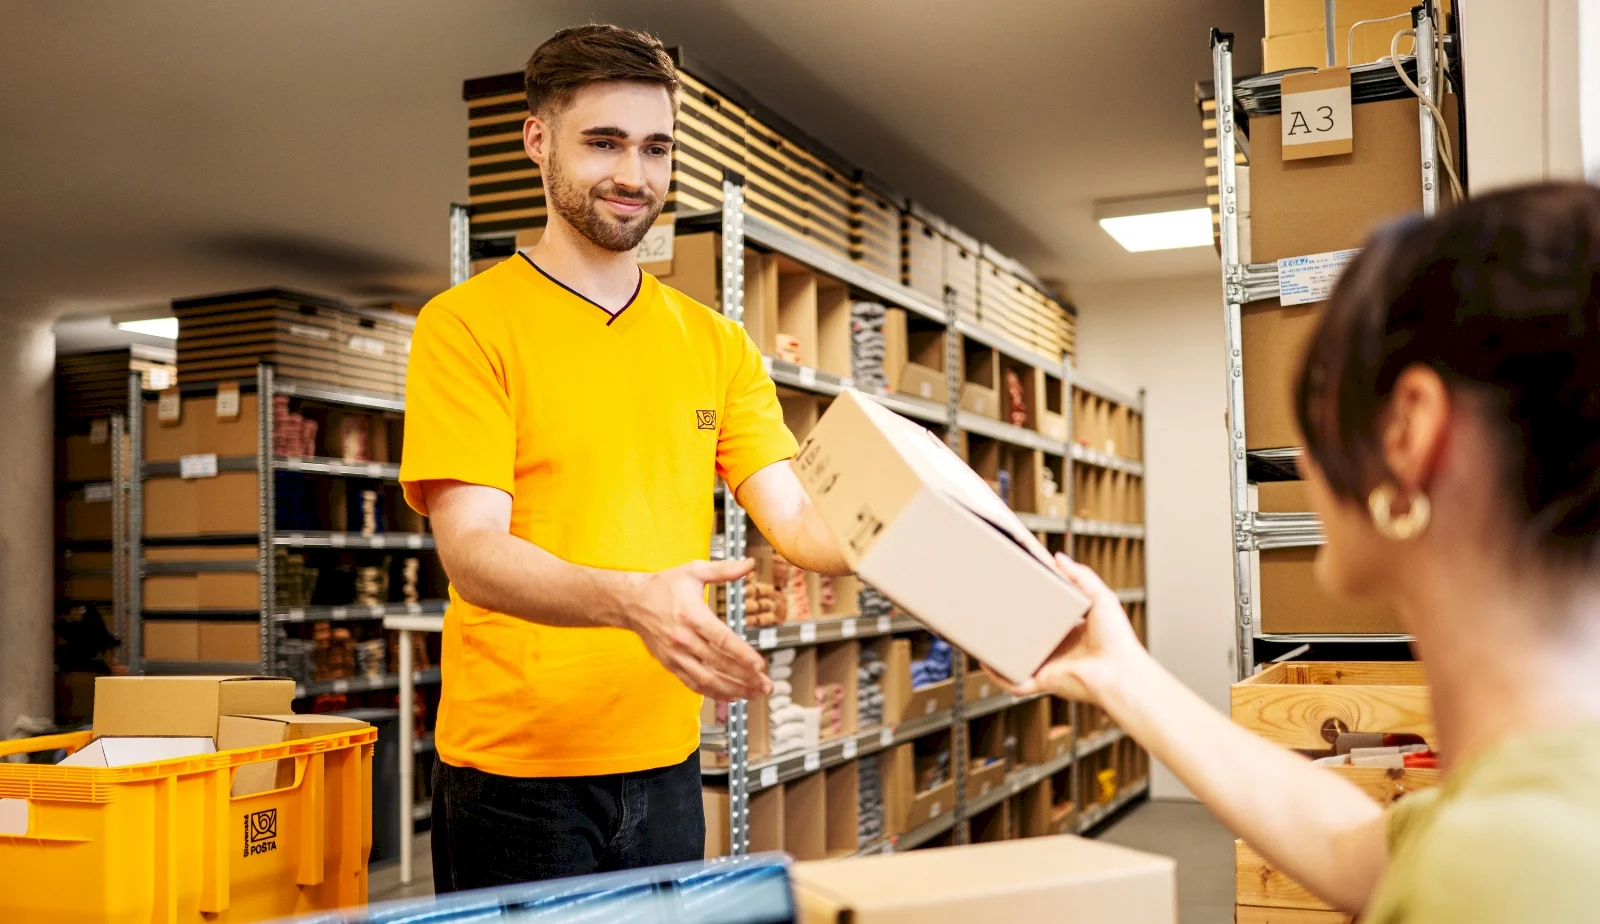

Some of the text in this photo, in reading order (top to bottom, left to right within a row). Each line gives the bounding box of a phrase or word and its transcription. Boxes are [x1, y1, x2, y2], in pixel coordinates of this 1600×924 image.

[1288, 106, 1334, 135] A3
[637, 235, 666, 258] A2
[251, 841, 277, 855] POŠTA
